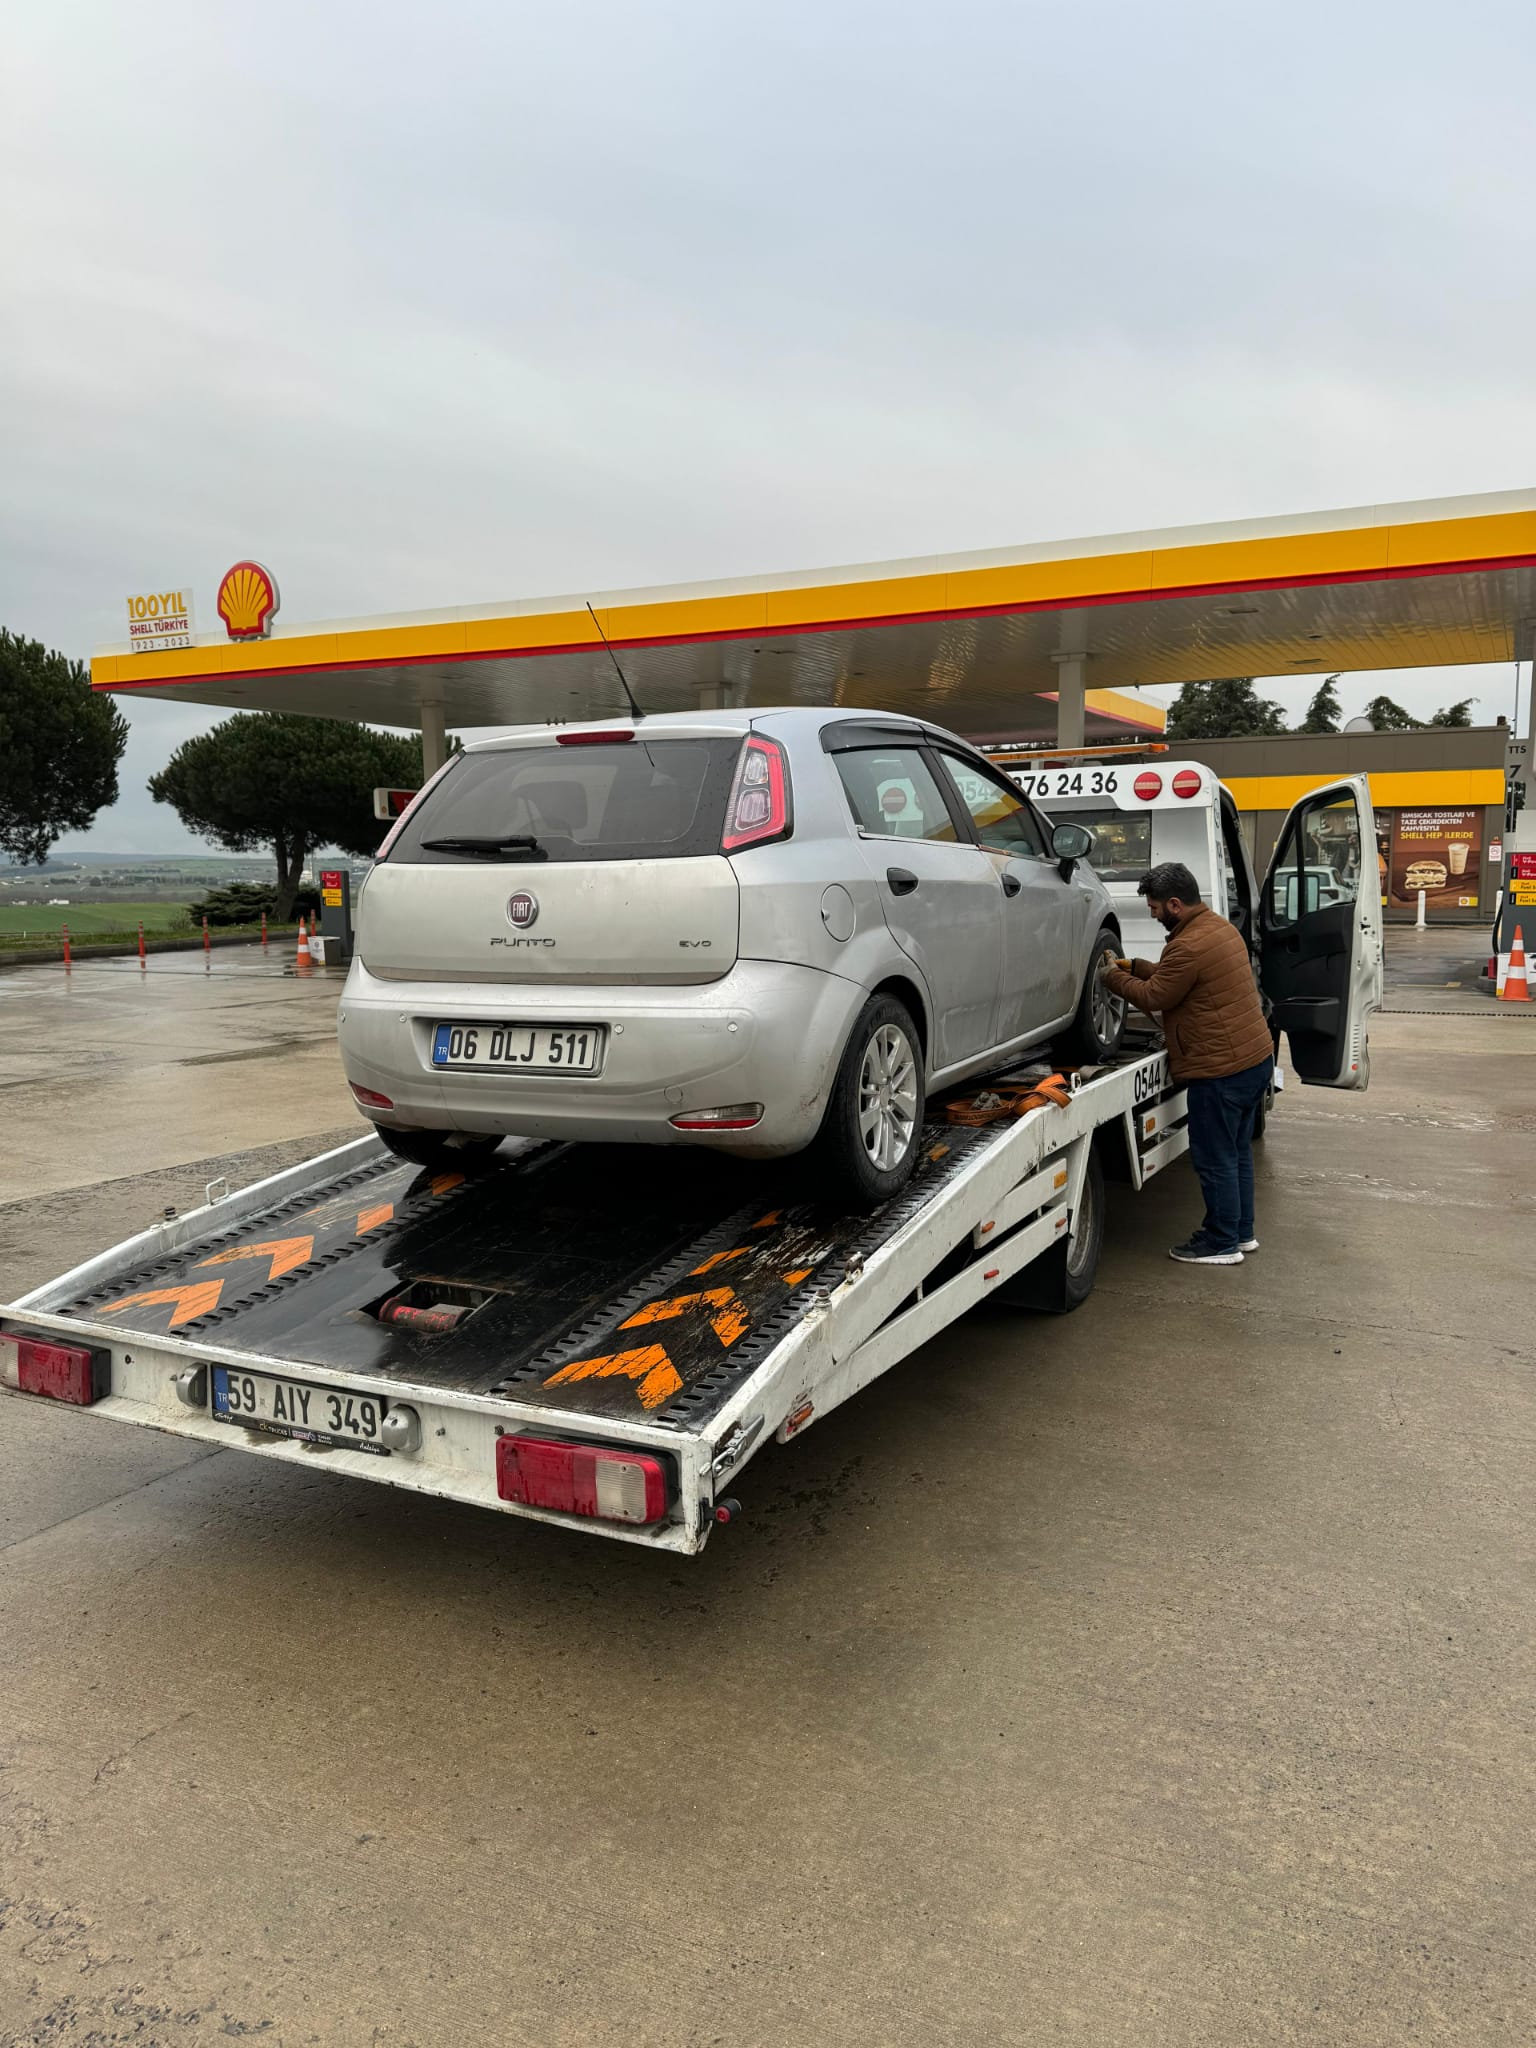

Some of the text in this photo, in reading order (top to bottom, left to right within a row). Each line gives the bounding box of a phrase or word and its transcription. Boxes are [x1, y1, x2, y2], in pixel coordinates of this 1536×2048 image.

[127, 591, 187, 618] 100YIL
[129, 617, 189, 636] SHELL TÜRKİYE
[131, 638, 154, 651] 1923
[164, 636, 190, 648] 2023
[1508, 745, 1527, 754] TTS
[1509, 764, 1522, 779] 7
[1056, 773, 1083, 795] 24
[1091, 771, 1118, 794] 36
[512, 902, 529, 918] FIAT
[490, 938, 556, 947] PUNTO
[438, 1029, 588, 1065] TR 06 DLJ 511
[1134, 1060, 1161, 1103] 0544
[217, 1374, 377, 1438] TR 59 AIY 349
